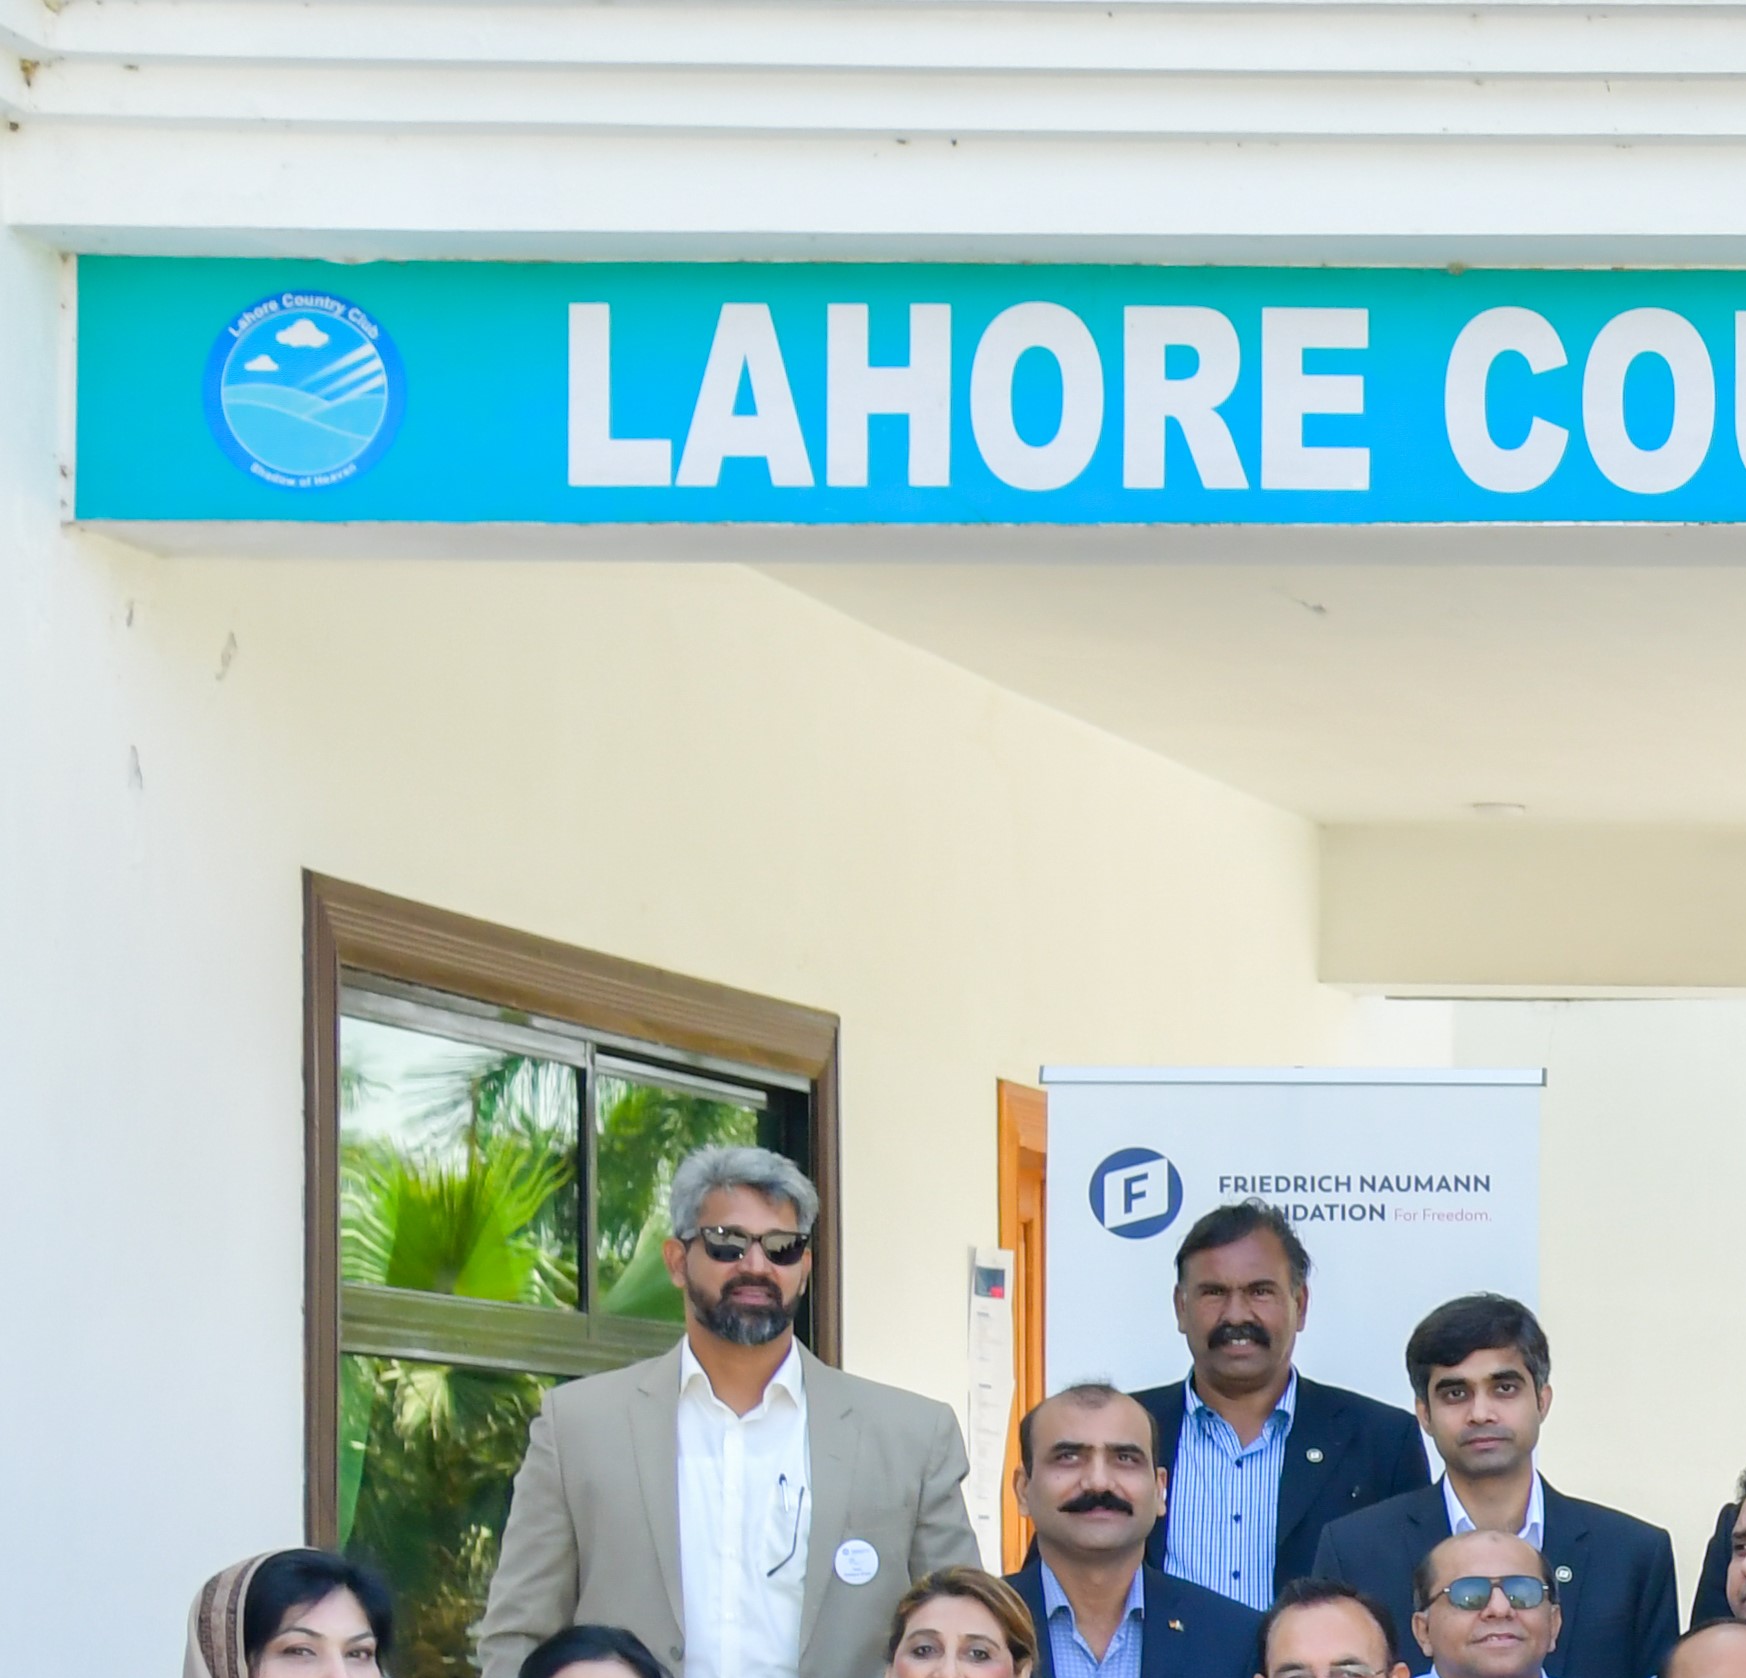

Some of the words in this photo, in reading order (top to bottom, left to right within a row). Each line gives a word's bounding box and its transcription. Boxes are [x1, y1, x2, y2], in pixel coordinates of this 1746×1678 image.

[228, 299, 279, 338] Lahore
[282, 293, 346, 317] Country
[348, 307, 379, 340] Club
[568, 302, 1370, 491] LAHORE
[250, 461, 296, 487] Shadow
[299, 475, 312, 488] of
[314, 462, 357, 486] Heaven
[1123, 1172, 1149, 1214] F
[1219, 1175, 1351, 1193] FRIEDRICH
[1359, 1174, 1491, 1193] NAUMANN
[1394, 1208, 1417, 1222] For
[1422, 1208, 1492, 1222] Freedom.
